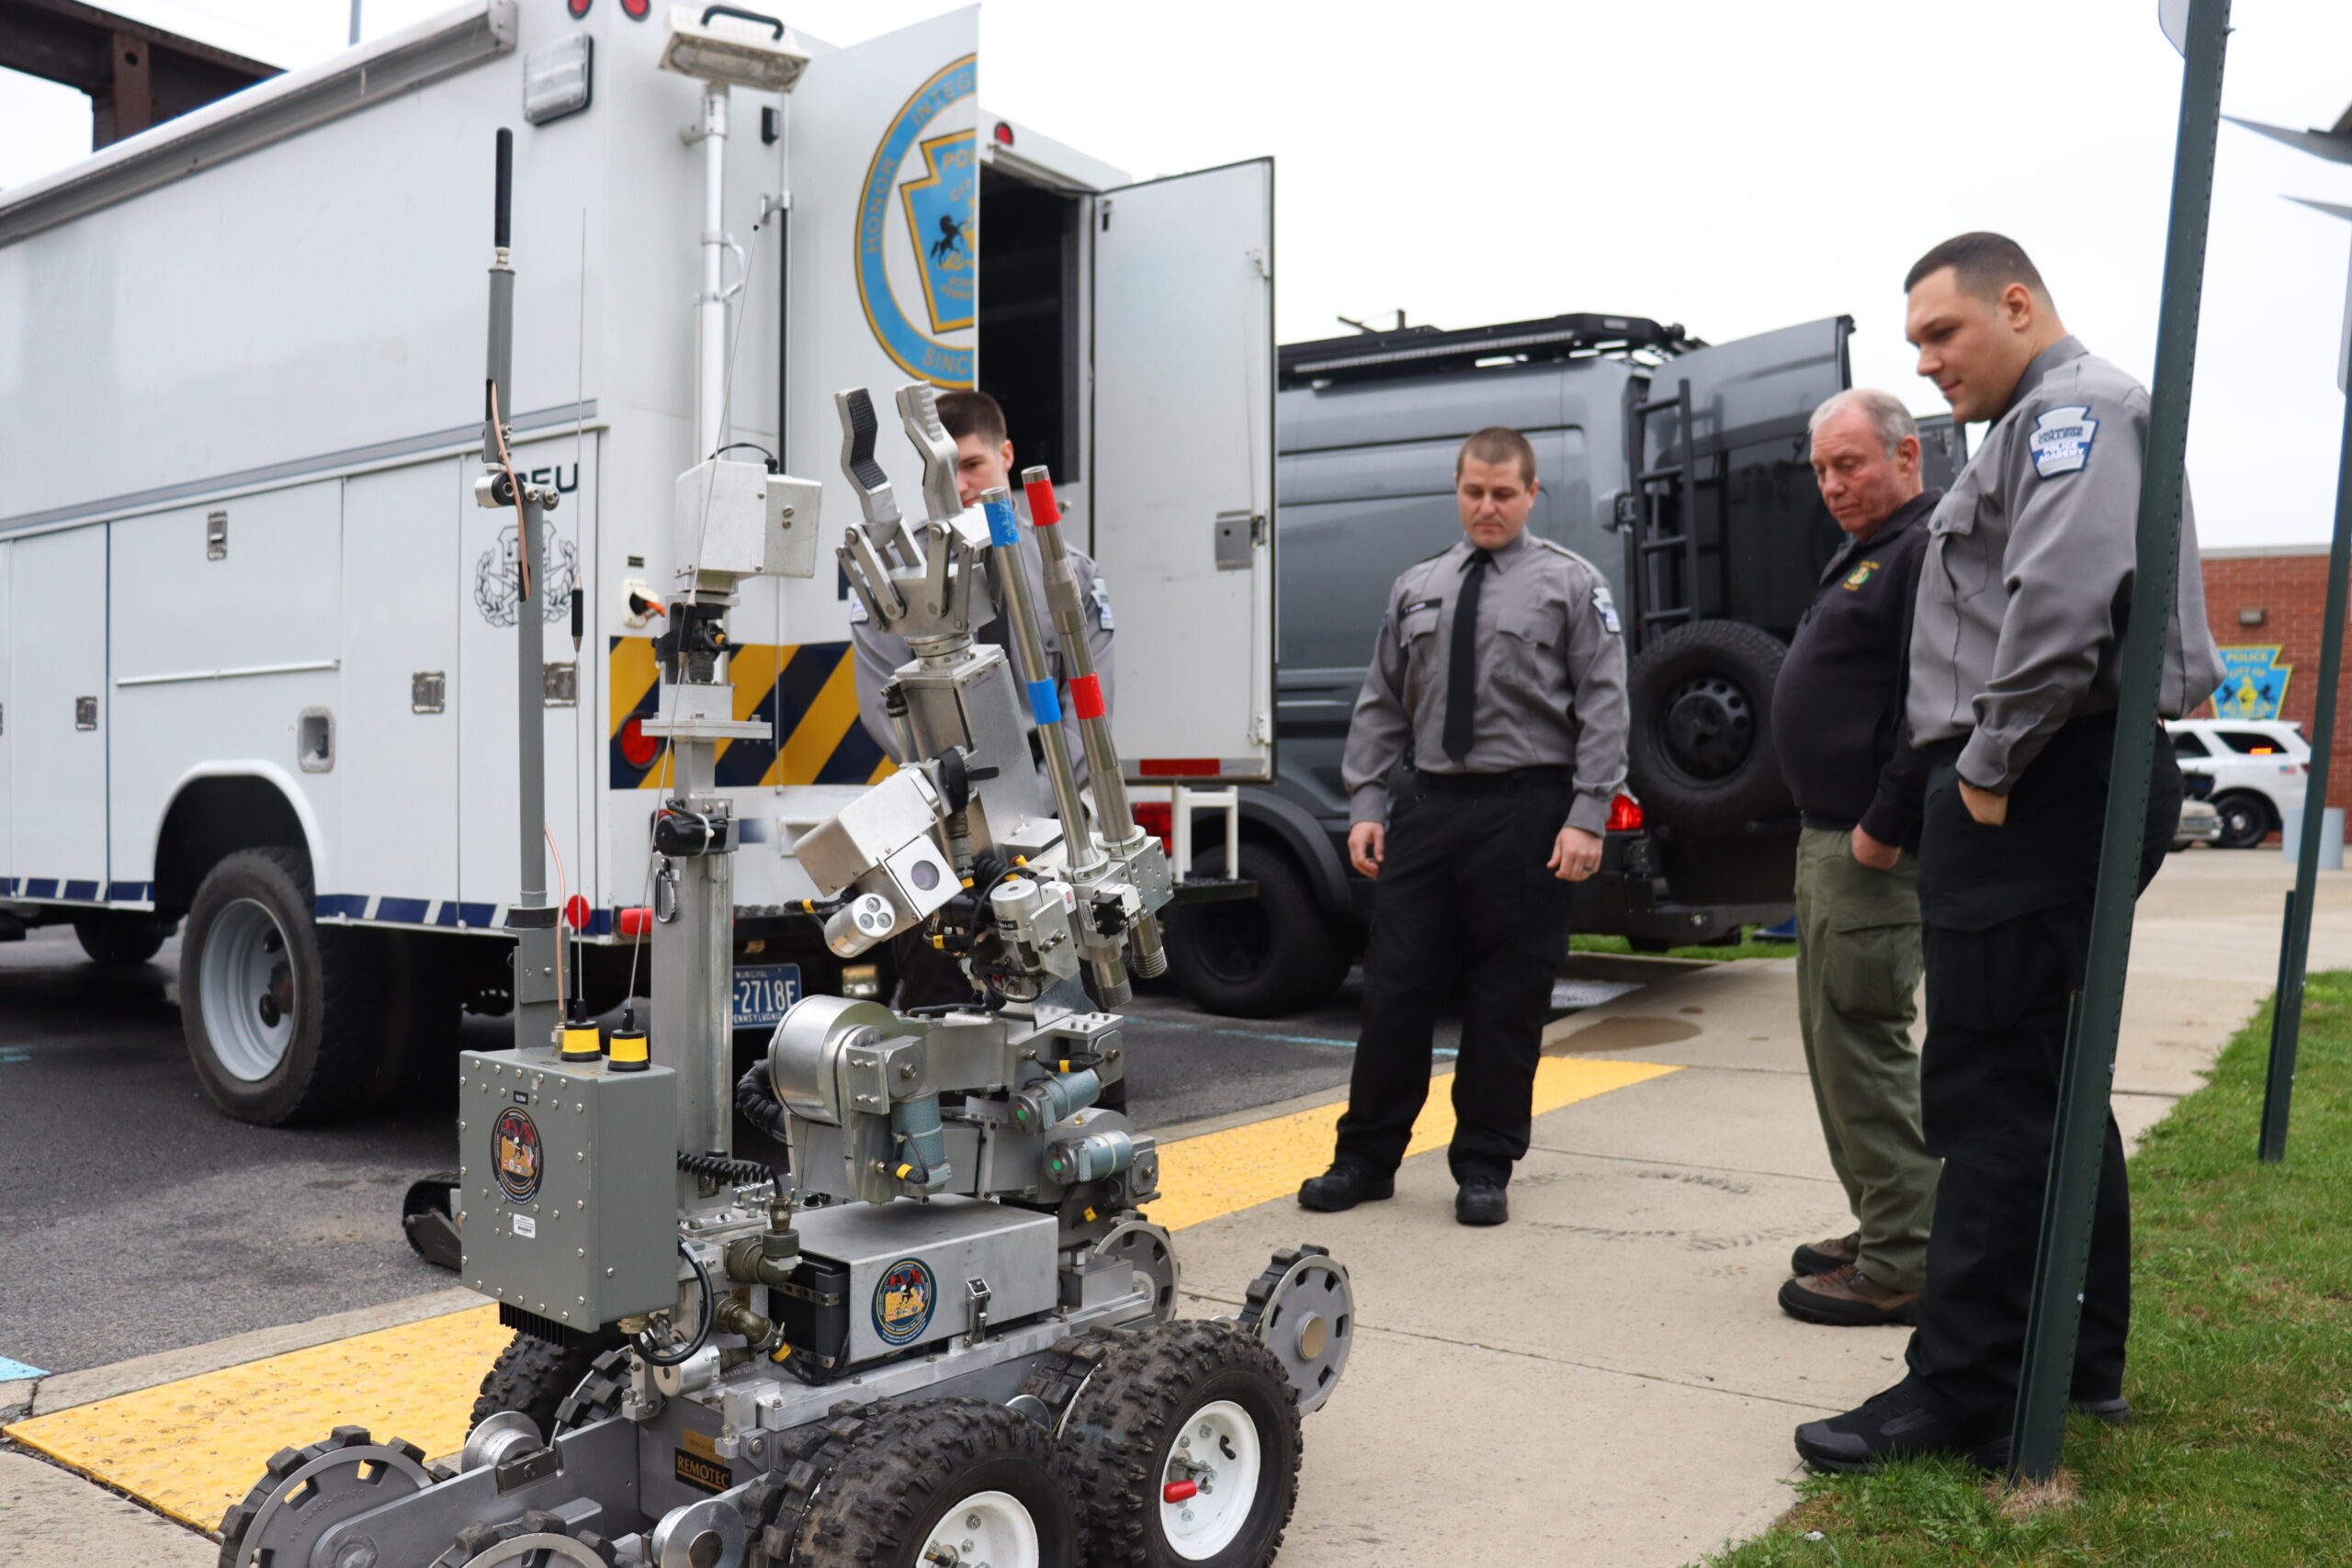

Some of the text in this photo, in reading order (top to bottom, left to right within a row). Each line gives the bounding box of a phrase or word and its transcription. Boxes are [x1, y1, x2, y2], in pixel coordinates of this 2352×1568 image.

[911, 71, 976, 126] INTEG
[865, 158, 896, 254] HONOR
[922, 346, 975, 376] SINC
[2037, 447, 2085, 463] ACADEMY
[2043, 441, 2079, 453] POLICE
[2226, 651, 2267, 662] POLICE
[735, 969, 769, 979] MUNICIPAL
[676, 1455, 730, 1488] REMOTEC
